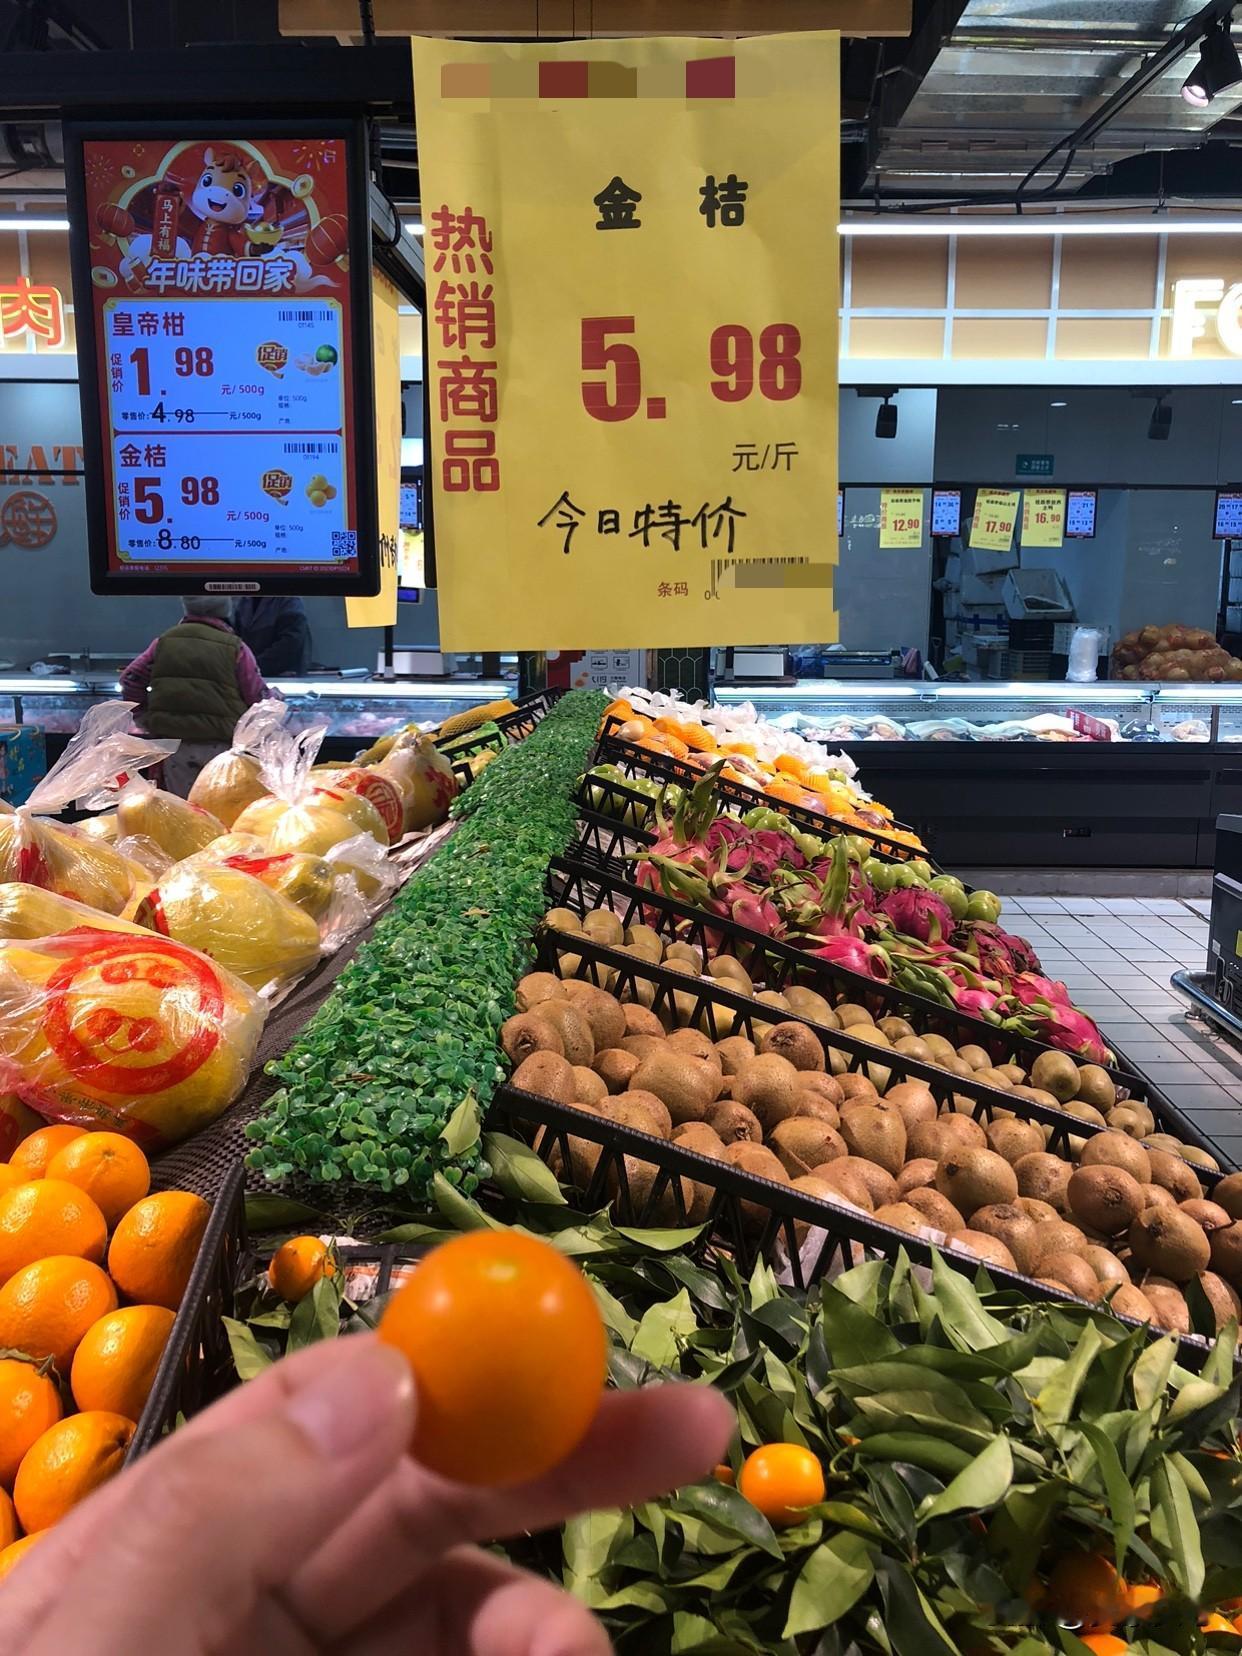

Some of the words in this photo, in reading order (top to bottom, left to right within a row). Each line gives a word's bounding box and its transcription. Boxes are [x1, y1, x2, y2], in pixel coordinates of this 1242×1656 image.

[593, 174, 749, 231] 金桔
[159, 199, 172, 252] 马上有福
[145, 258, 294, 293] 年味带回家
[0, 276, 64, 347] 肉
[112, 312, 185, 336] 皇帝柑
[431, 204, 500, 493] 热销商品
[111, 354, 124, 392] 促销价
[119, 444, 167, 468] 金桔
[731, 442, 799, 472] 元/斤
[118, 482, 131, 521] 促销价
[1035, 512, 1061, 524] 16.90
[537, 491, 747, 554] 今日特价
[892, 518, 920, 532] 12.90
[985, 520, 1012, 534] 17.90
[657, 581, 689, 597] 条码
